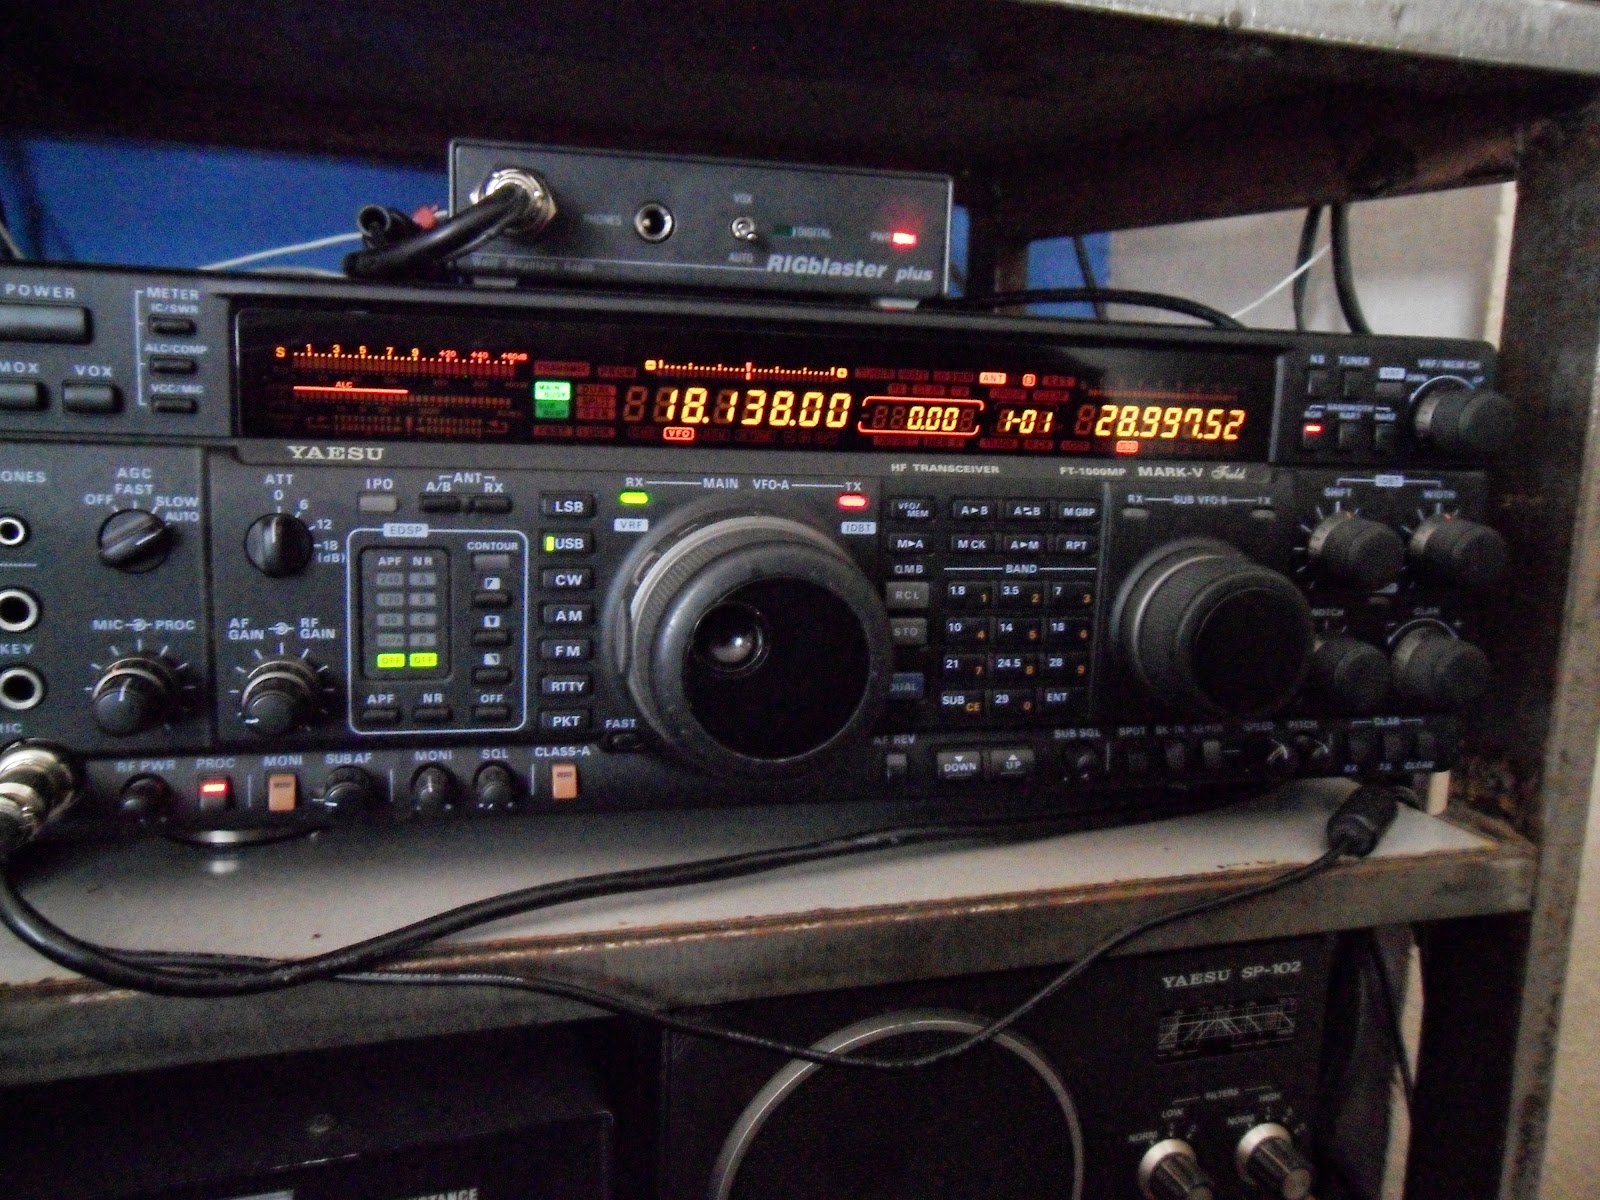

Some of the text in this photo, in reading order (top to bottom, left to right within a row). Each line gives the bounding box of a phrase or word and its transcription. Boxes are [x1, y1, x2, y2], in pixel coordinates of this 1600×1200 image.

[766, 253, 934, 283] RIGblaster plus
[5, 283, 76, 299] POWER
[147, 287, 200, 300] METER
[150, 303, 198, 314] IC/SWR
[145, 344, 207, 355] ALC/COMP
[275, 346, 286, 359] S
[0, 361, 39, 374] MOX
[73, 365, 113, 378] VOX
[666, 387, 852, 428] 18.138.00
[906, 405, 960, 432] 0.00
[1094, 404, 1247, 441] 28.997.52
[287, 445, 385, 461] YAESU
[116, 467, 152, 479] AGC
[891, 463, 1000, 474] HF TRANSCEIVER
[1138, 466, 1204, 478] MARK-V
[264, 474, 294, 485] ATT
[453, 472, 482, 483] ANT
[114, 483, 154, 495] FAST
[366, 478, 394, 490] IPO
[426, 481, 452, 492] A/B
[484, 482, 504, 493] RX
[625, 477, 862, 491] RX MAIN VFO-A TX
[84, 493, 114, 505] OFF
[155, 496, 199, 507] SLOW
[555, 501, 584, 512] LSB
[164, 511, 200, 522] AUTO
[389, 525, 423, 535] EDSP
[620, 520, 643, 530] VRF
[466, 541, 519, 550] CONTOUR
[555, 538, 584, 549] USB
[1065, 541, 1087, 550] RPT
[378, 556, 402, 565] APF
[894, 565, 924, 574] QMB
[1005, 564, 1038, 574] BAND
[555, 574, 583, 586] CW
[1002, 586, 1020, 595] 3.5
[556, 610, 583, 621] AM
[93, 619, 196, 631] MIC PROC
[229, 617, 319, 628] AF RF
[948, 622, 962, 632] 10
[1000, 623, 1013, 632] 14
[1052, 622, 1065, 632] 18
[228, 628, 336, 640] GAIN GAIN
[946, 659, 959, 669] 21
[1049, 658, 1064, 667] 28
[551, 681, 585, 692] RTTY
[367, 693, 395, 704] APF
[422, 693, 443, 703] NR
[480, 694, 504, 703] OFF
[942, 695, 965, 705] SUB
[995, 695, 1009, 704] 29
[1047, 692, 1068, 702] ENT
[966, 702, 981, 712] CE
[553, 715, 581, 727] PKT
[605, 719, 637, 729] FAST
[415, 750, 453, 761] MONI
[481, 748, 509, 760] SQL
[534, 746, 592, 757] CLASS-A
[196, 758, 236, 769] PROC
[263, 756, 303, 767] MONI
[325, 752, 372, 764] SUB AF
[140, 760, 176, 771] PWR
[944, 762, 977, 772] DOWN
[1006, 760, 1021, 769] UP
[1161, 961, 1302, 989] YAESU SP-102
